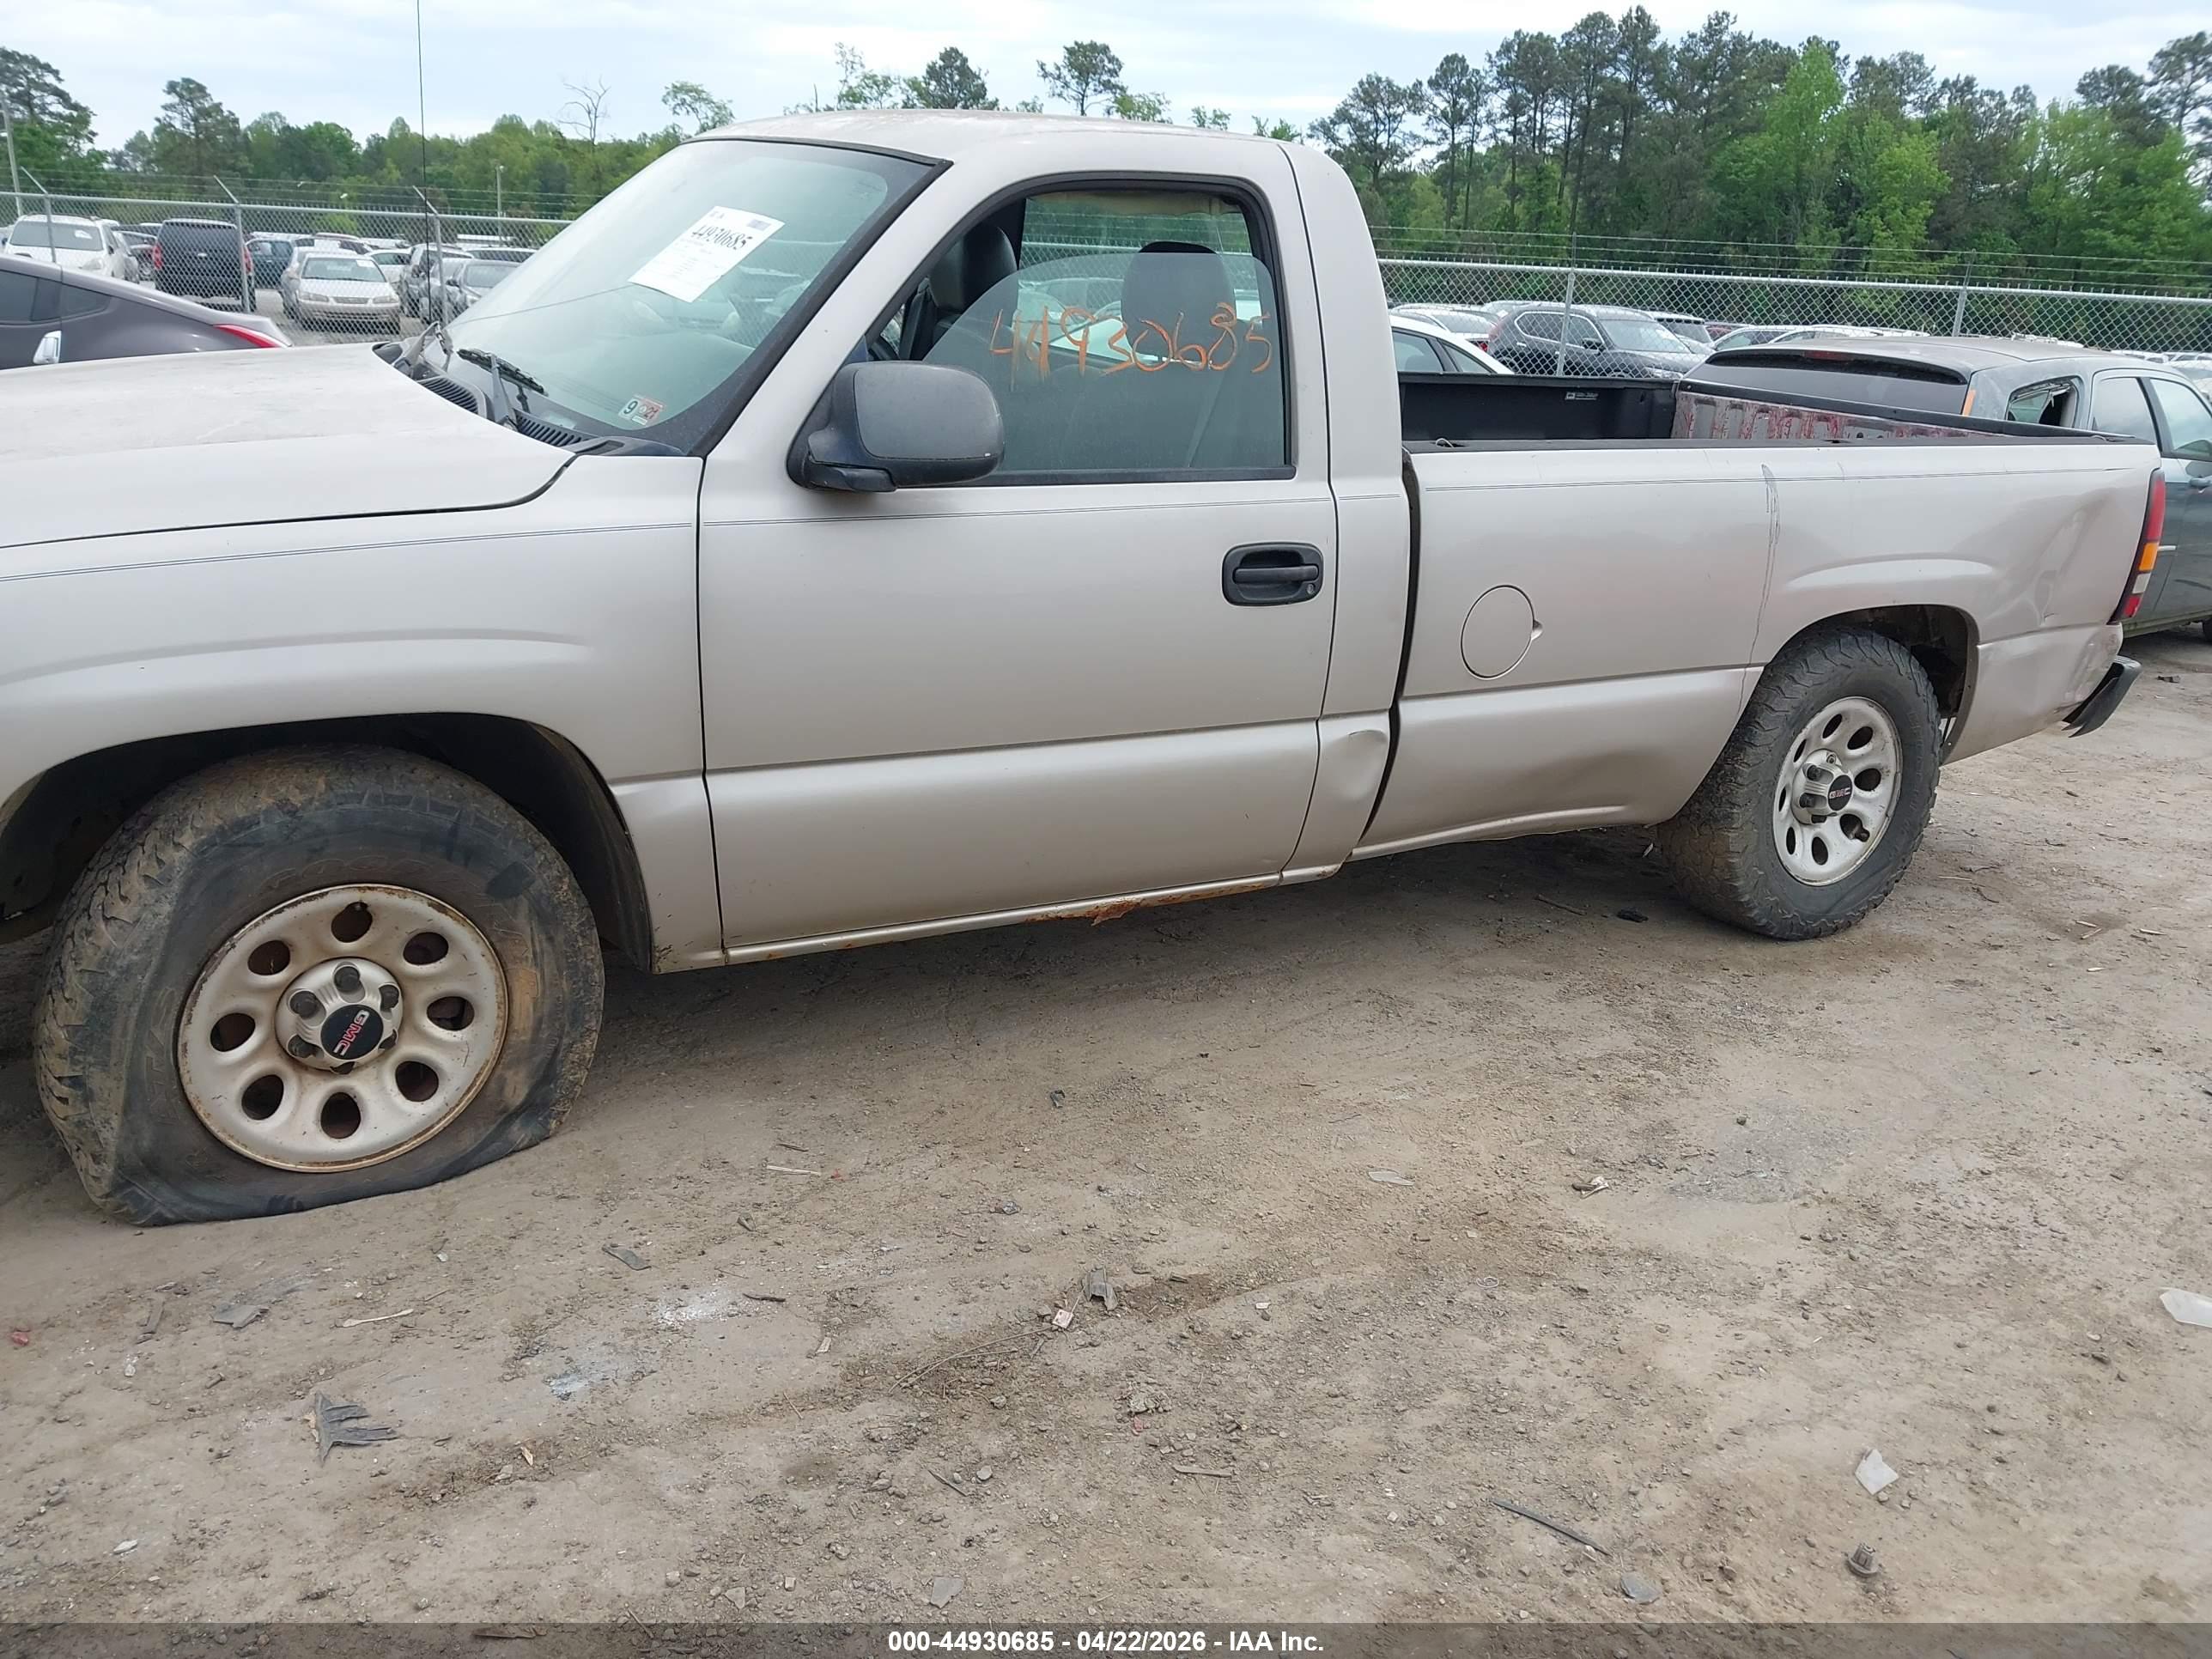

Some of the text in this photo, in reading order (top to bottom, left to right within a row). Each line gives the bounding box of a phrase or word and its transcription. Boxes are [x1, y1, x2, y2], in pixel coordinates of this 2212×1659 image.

[692, 224, 753, 251] 44930685
[989, 302, 1271, 392] 44930685
[623, 400, 638, 414] 9
[1829, 787, 1850, 799] GMC
[333, 1009, 370, 1056] GMC
